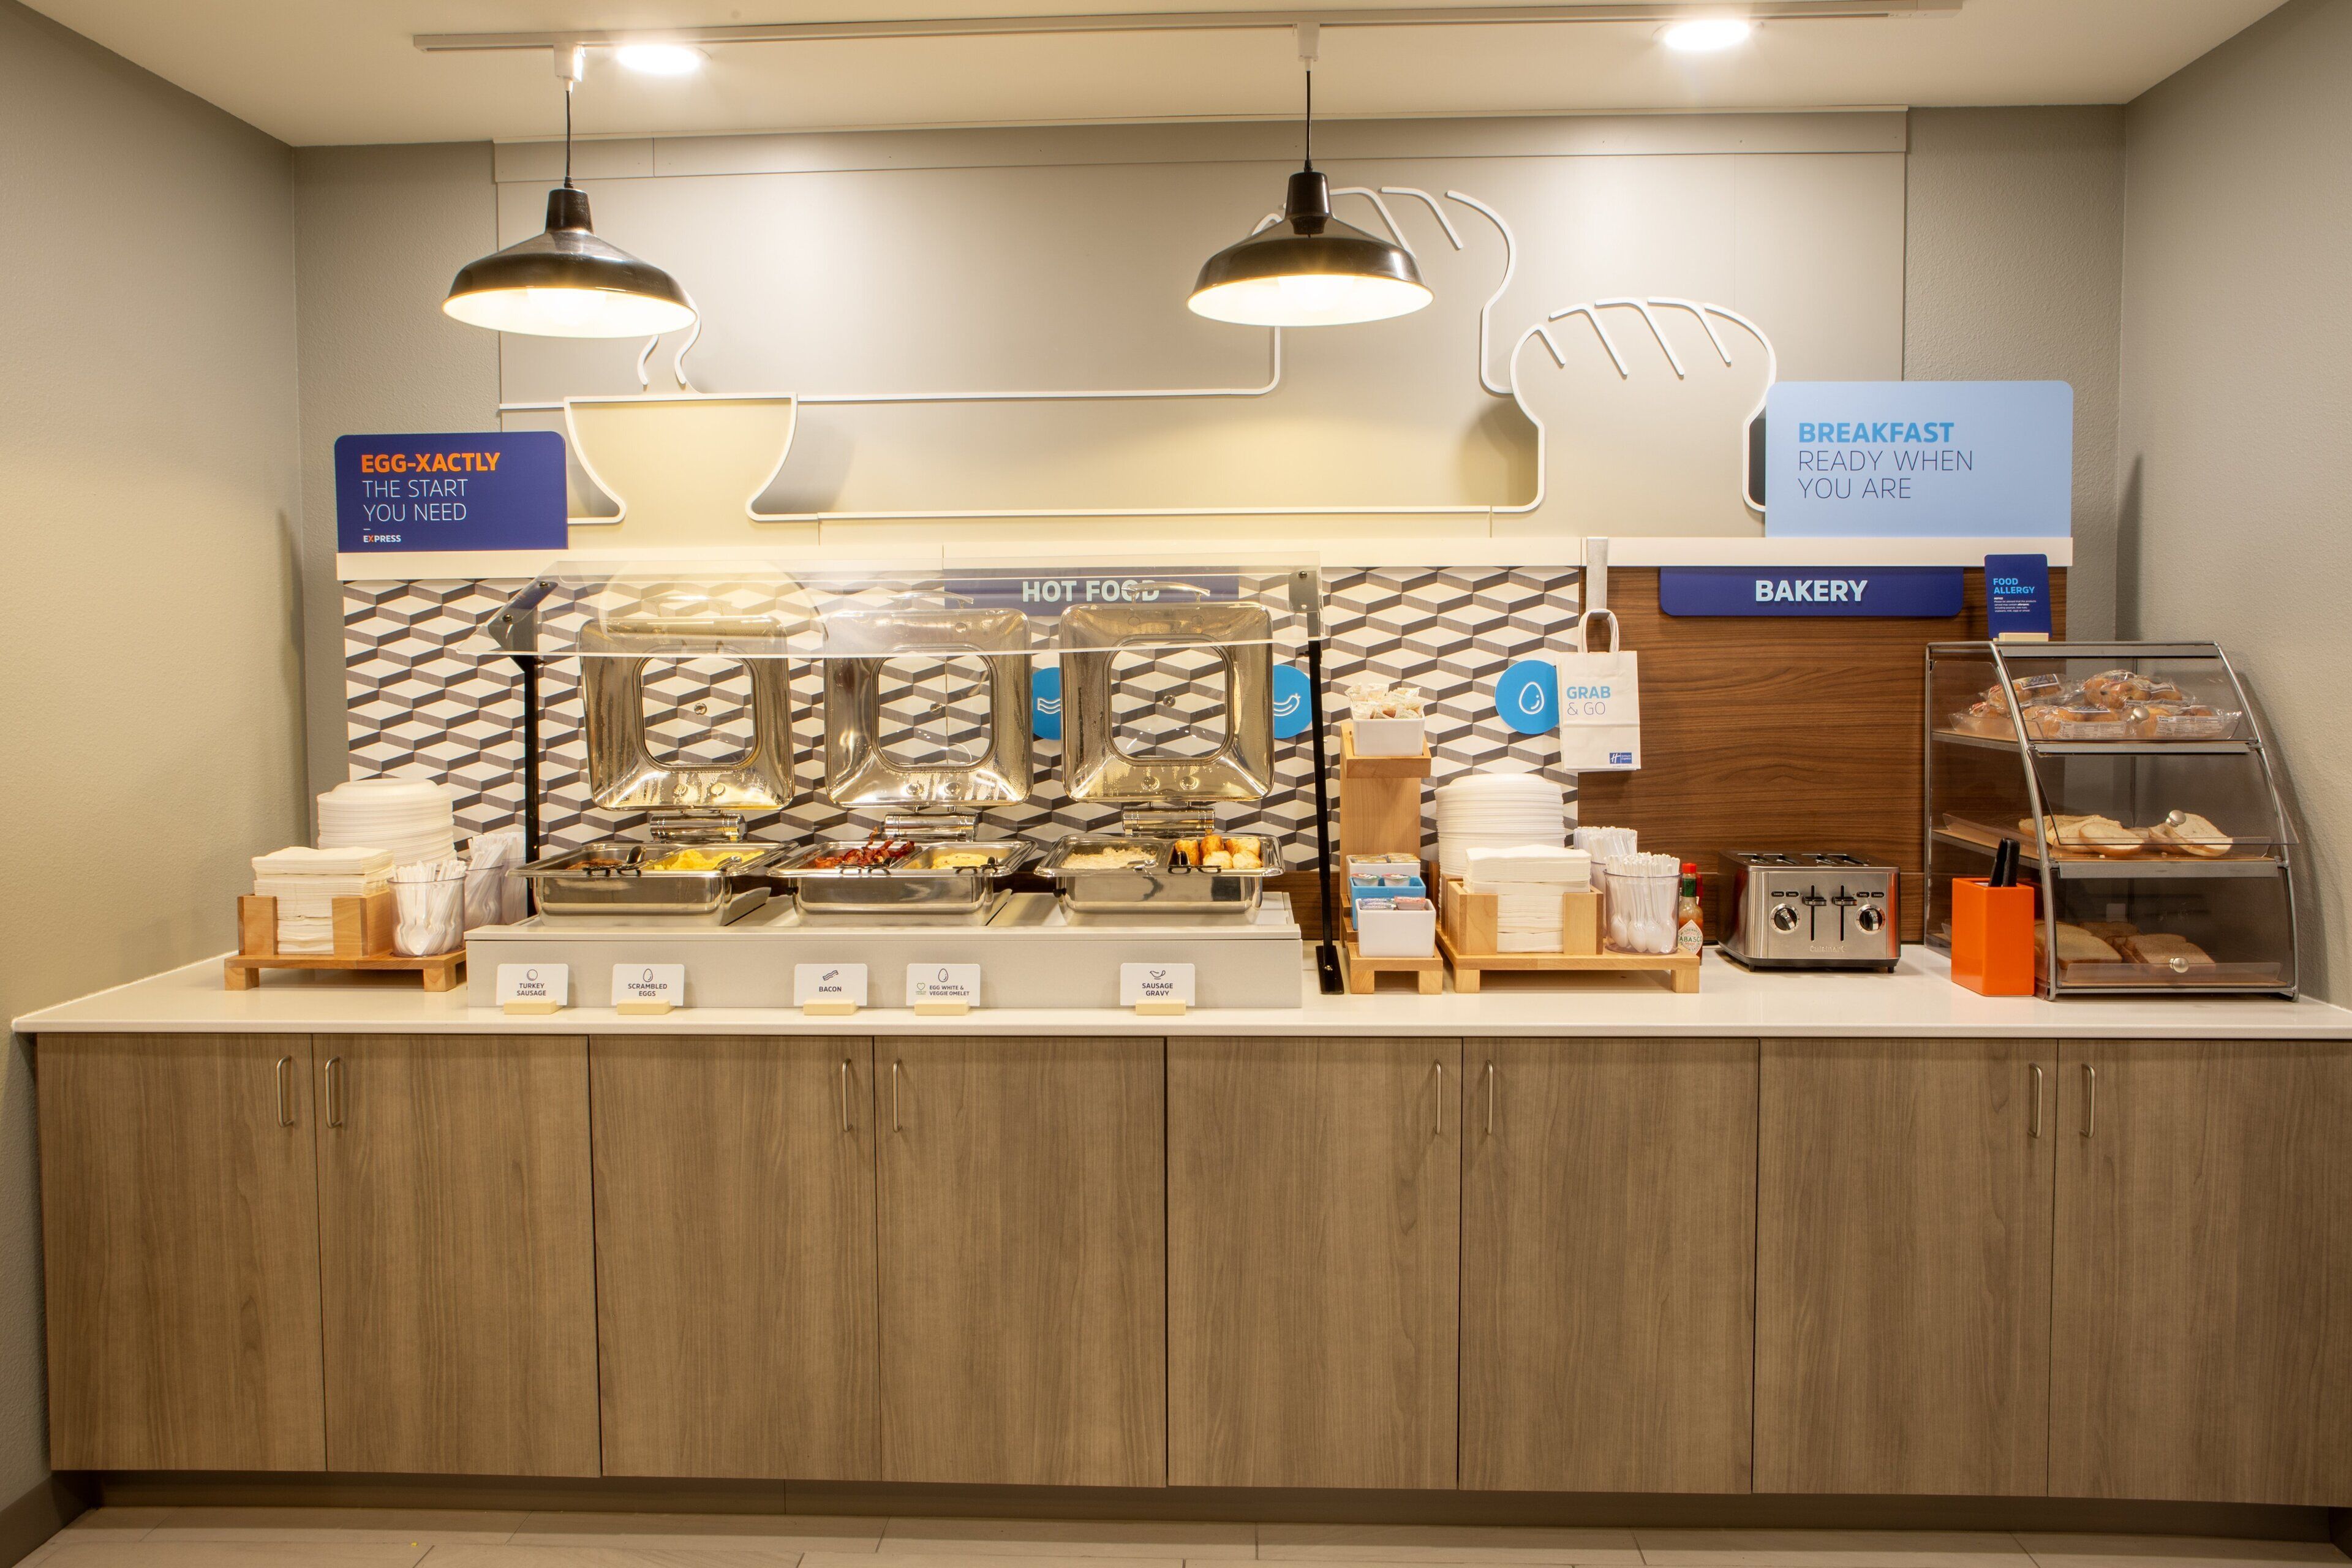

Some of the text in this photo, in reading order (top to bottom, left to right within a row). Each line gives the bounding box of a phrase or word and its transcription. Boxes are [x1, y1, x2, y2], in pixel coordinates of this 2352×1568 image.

[1799, 423, 1954, 443] BREAKFAST
[361, 453, 500, 473] EGG-XACTLY
[1799, 450, 1972, 471] READY WHEN
[362, 479, 468, 497] THE START
[1798, 478, 1911, 499] YOU ARE
[363, 503, 467, 522] YOU NEED
[1022, 579, 1159, 602] HOT FOOD
[1756, 580, 1868, 601] BAKERY
[1566, 686, 1611, 699] GRAB
[1567, 701, 1605, 715] & GO
